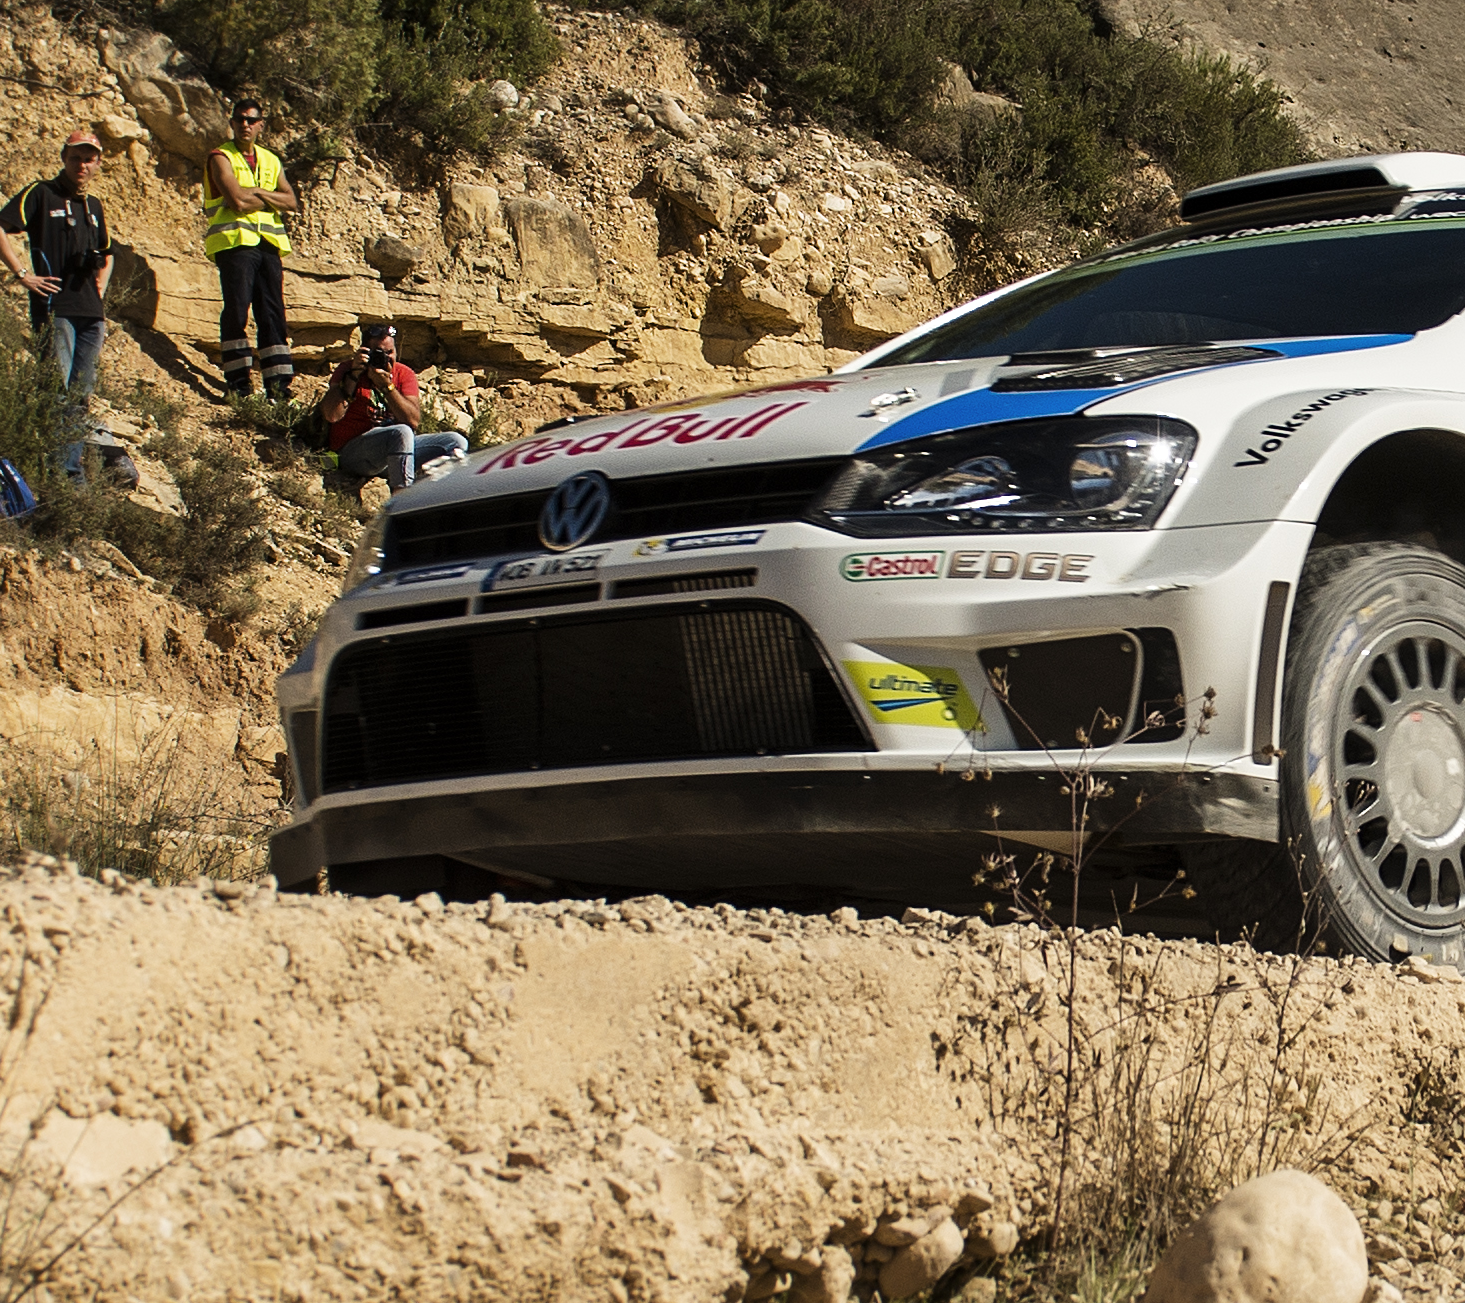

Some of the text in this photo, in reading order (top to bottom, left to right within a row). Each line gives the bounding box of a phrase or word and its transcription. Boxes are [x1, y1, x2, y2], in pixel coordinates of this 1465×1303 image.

[476, 401, 811, 475] Red Bull
[1233, 388, 1380, 468] Volkswag
[866, 549, 1096, 583] Castrol EDGE
[869, 674, 959, 696] ultimate
